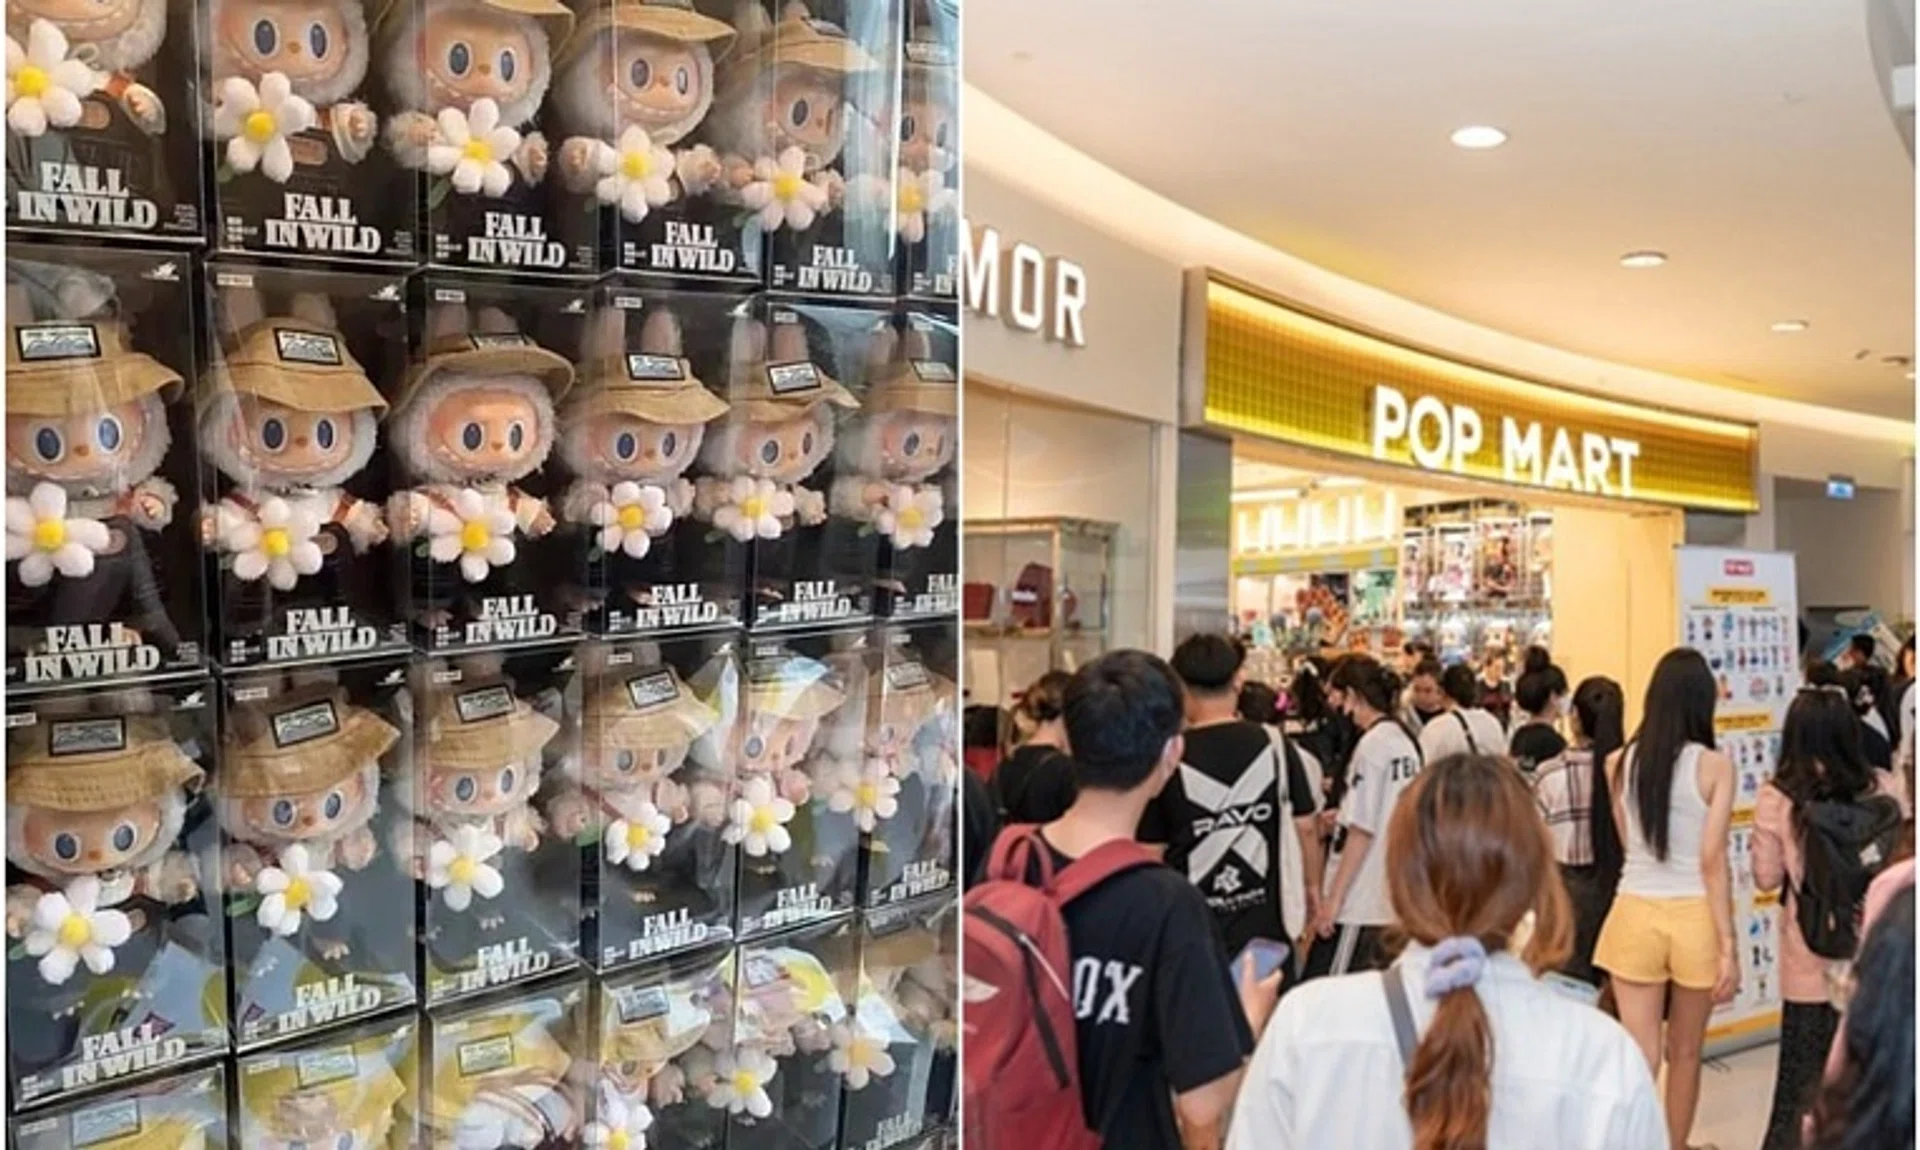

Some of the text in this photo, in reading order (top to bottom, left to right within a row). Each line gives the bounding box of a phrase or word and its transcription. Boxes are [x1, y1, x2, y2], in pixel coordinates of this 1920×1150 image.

[41, 161, 129, 197] FALL
[18, 191, 57, 222] IN
[61, 193, 158, 230] WILD
[284, 192, 358, 225] FALL
[265, 219, 298, 248] IN
[302, 222, 381, 254] WILD
[485, 211, 547, 241] FALL
[665, 221, 718, 248] FALL
[468, 237, 496, 263] IN
[500, 239, 566, 268] WILD
[652, 244, 675, 268] IN
[677, 247, 734, 273] WILD
[813, 245, 860, 271] FALL
[798, 266, 820, 289] IN
[822, 269, 872, 292] WILD
[960, 218, 1087, 346] MOR
[1372, 383, 1641, 498] POP MART
[651, 583, 703, 605] FALL
[795, 579, 839, 602] FALL
[286, 606, 356, 634] FALL
[482, 594, 539, 620] FALL
[636, 607, 660, 628] IN
[662, 602, 718, 626] WILD
[45, 622, 131, 653] FALL
[267, 636, 298, 660] IN
[302, 626, 377, 655] WILD
[466, 621, 492, 645] IN
[494, 614, 557, 640] WILD
[25, 654, 62, 683] IN
[65, 645, 160, 678] WILD
[643, 907, 693, 937] FALL
[478, 937, 533, 969] FALL
[296, 973, 361, 1008] FALL
[82, 1022, 160, 1061] FALL
[98, 1038, 186, 1077] WILD
